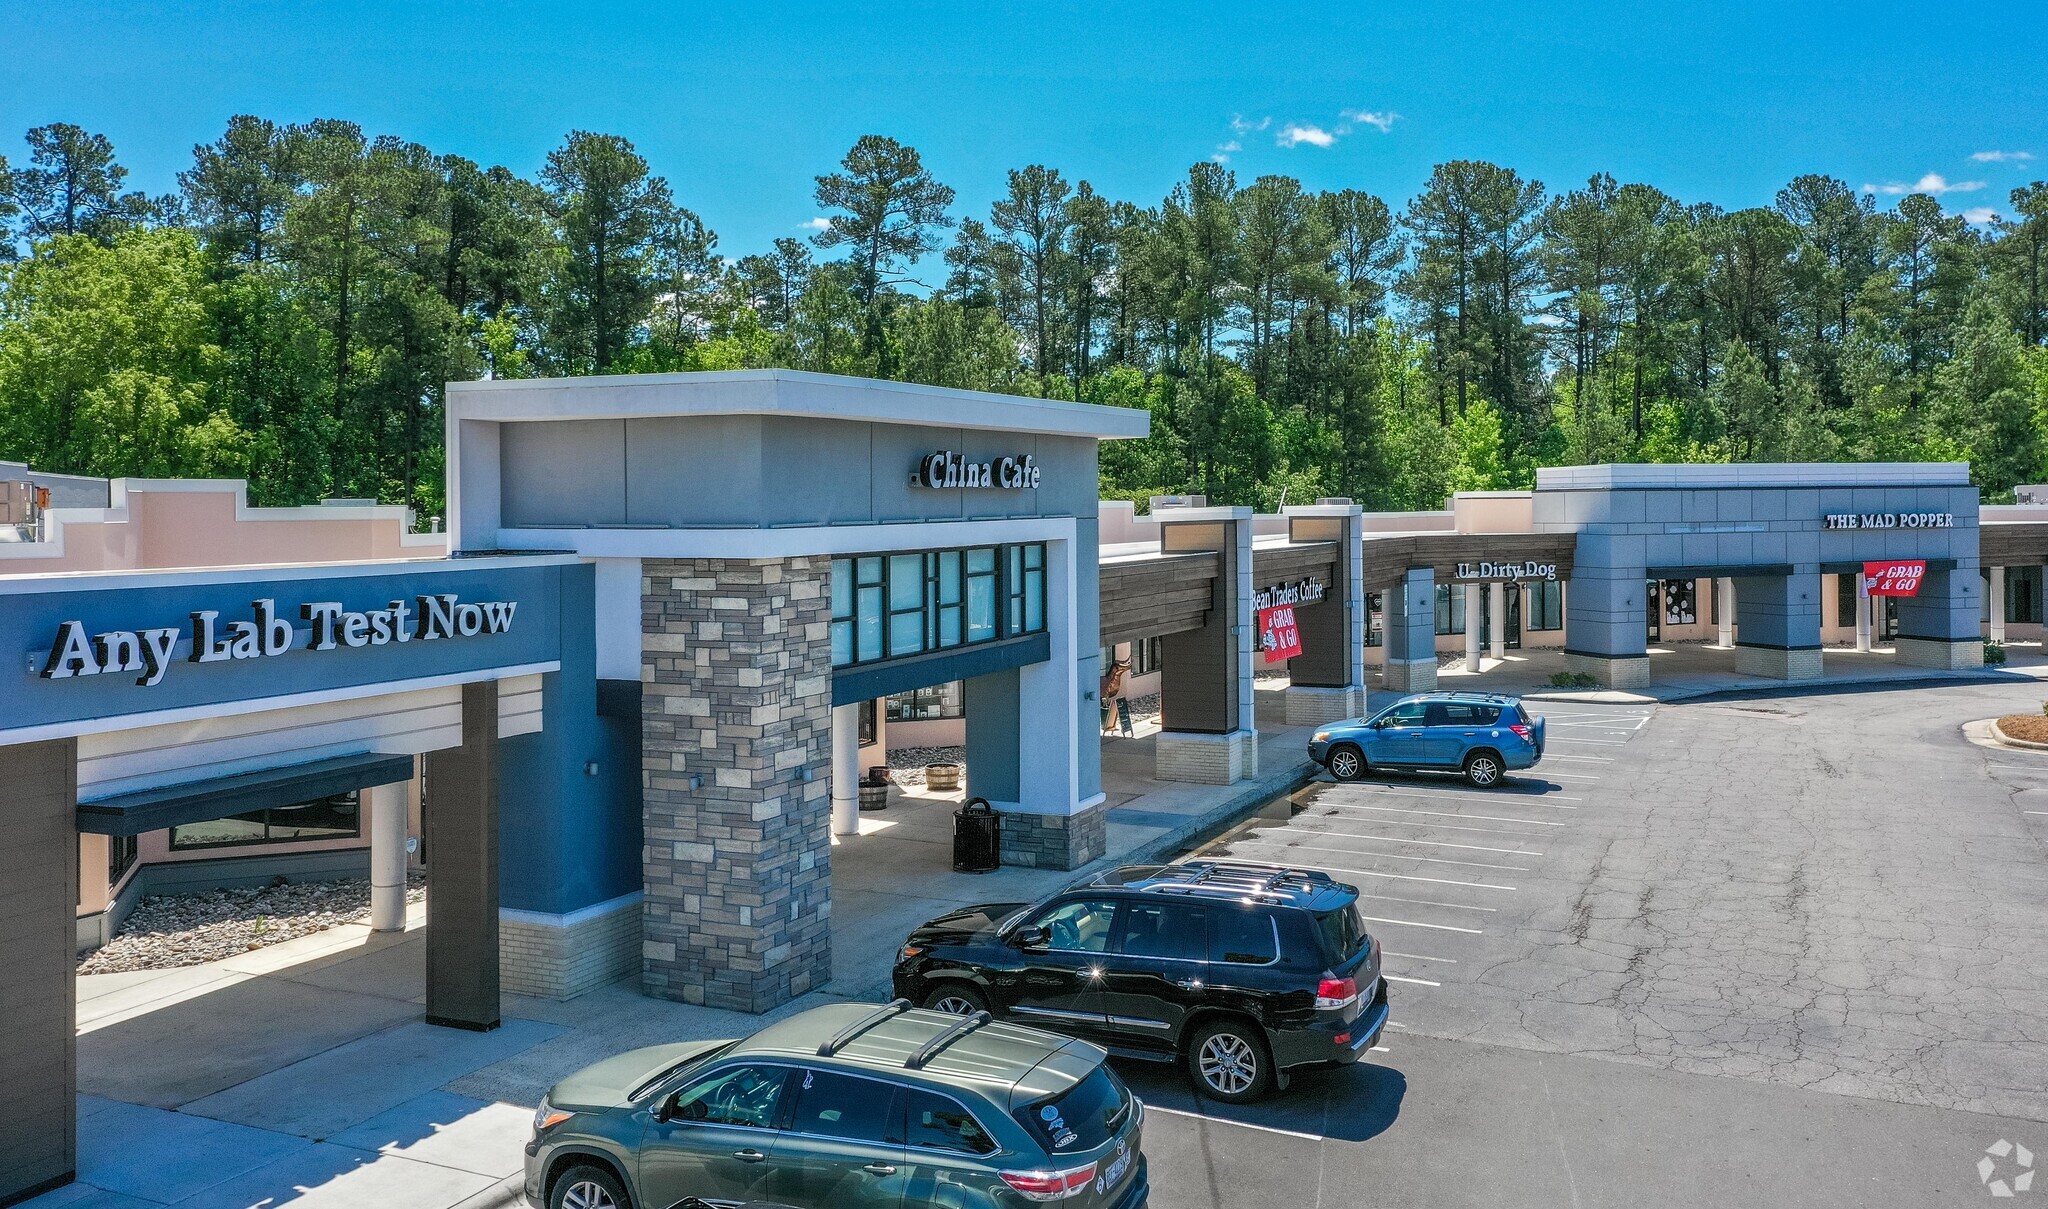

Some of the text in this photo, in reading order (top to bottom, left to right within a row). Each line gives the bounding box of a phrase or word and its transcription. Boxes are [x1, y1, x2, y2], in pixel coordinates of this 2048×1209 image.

[925, 451, 1041, 489] China Cafe
[1826, 513, 1954, 529] THE MAD POPPER
[1457, 561, 1557, 582] U Dirty Dog
[1886, 565, 1923, 579] GRAB
[1252, 576, 1323, 611] Bean Traders Coffee
[1880, 578, 1917, 591] & GO
[1273, 608, 1294, 628] GRAB
[41, 593, 518, 687] Any Lab Test Now
[1279, 628, 1297, 649] & GO
